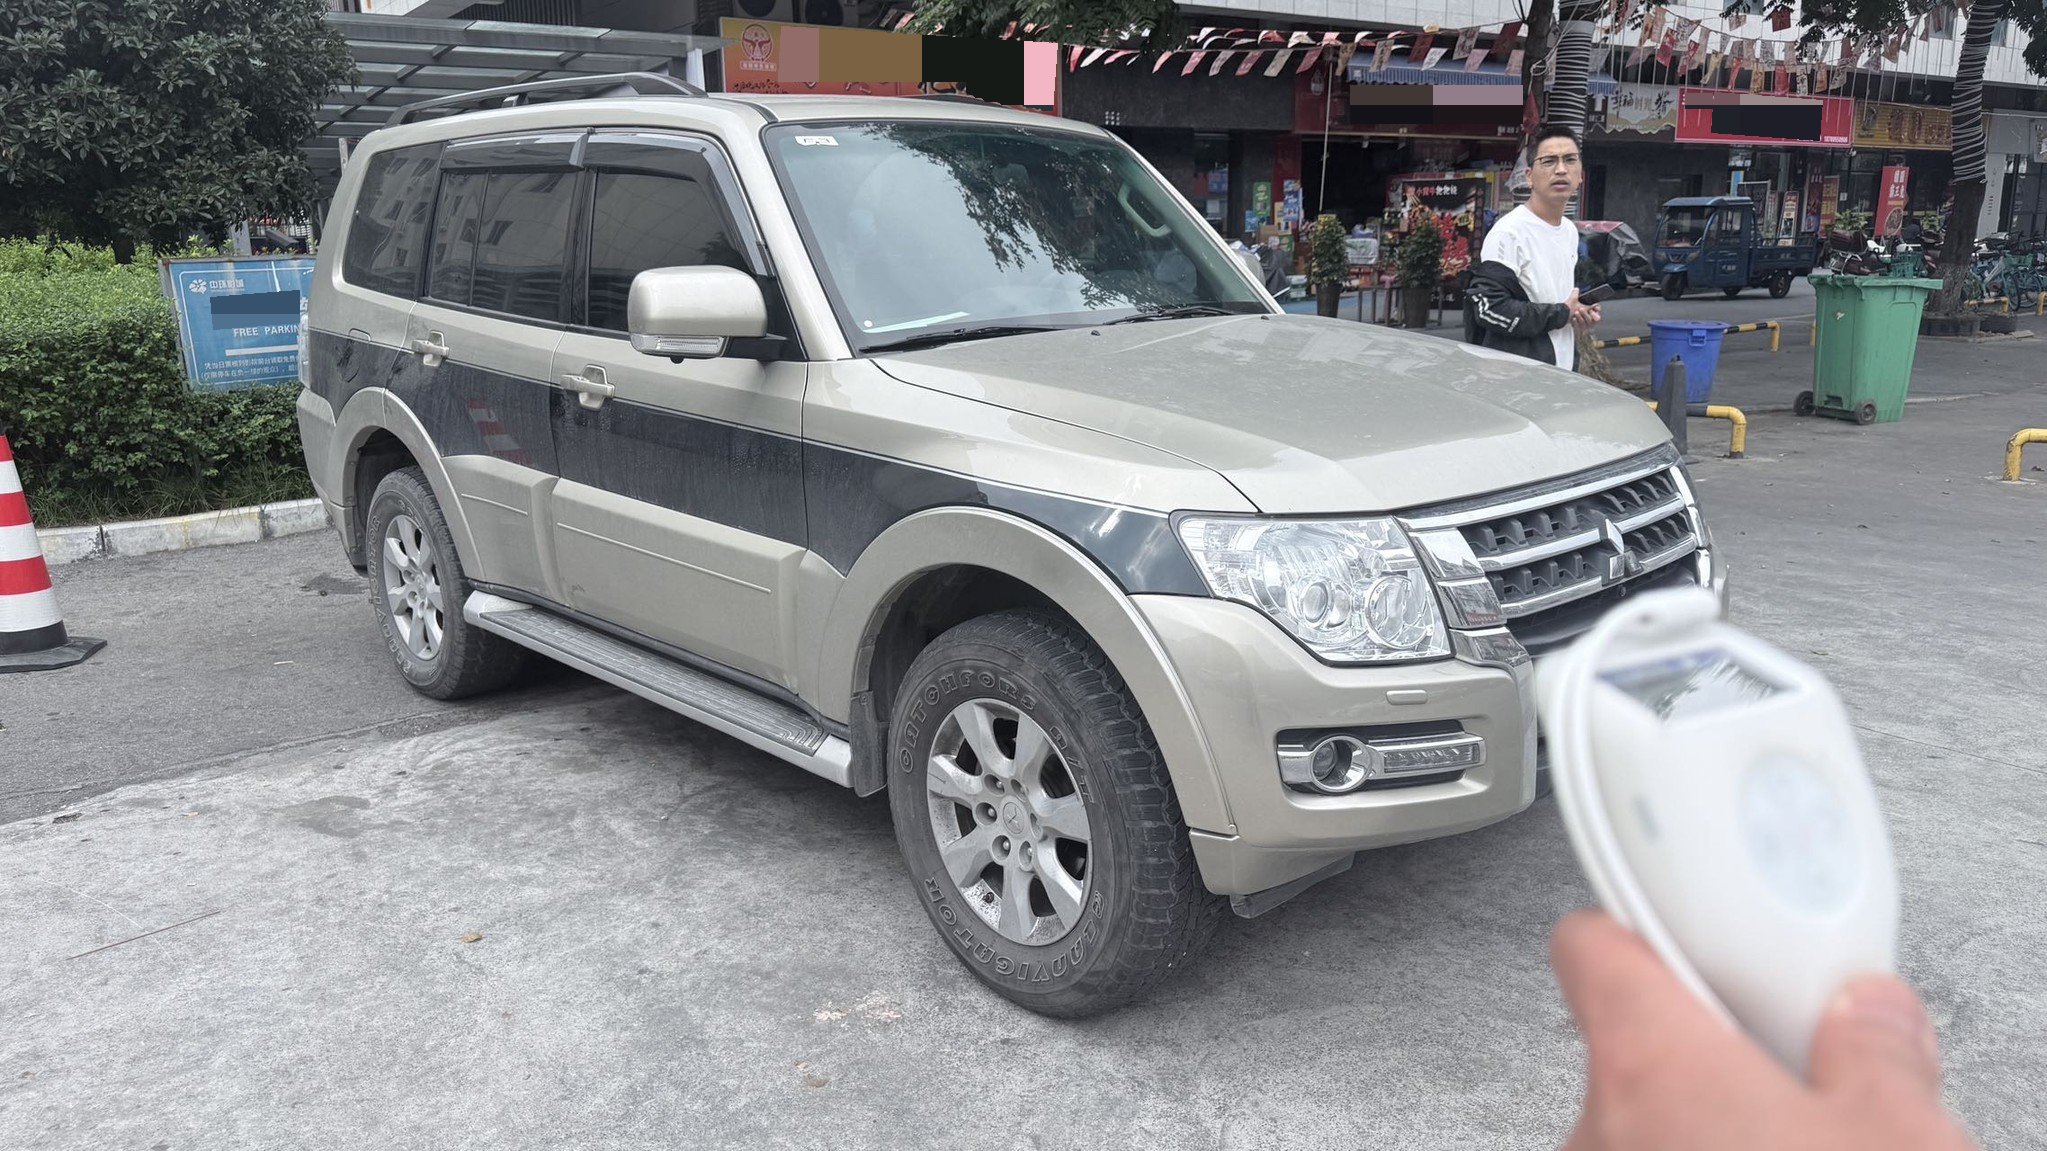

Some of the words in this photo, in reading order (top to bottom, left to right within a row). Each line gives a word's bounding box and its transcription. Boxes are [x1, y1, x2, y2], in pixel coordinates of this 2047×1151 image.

[233, 327, 259, 337] FREE
[264, 324, 299, 335] PARKIN
[925, 877, 1098, 982] LANVIGATOR
